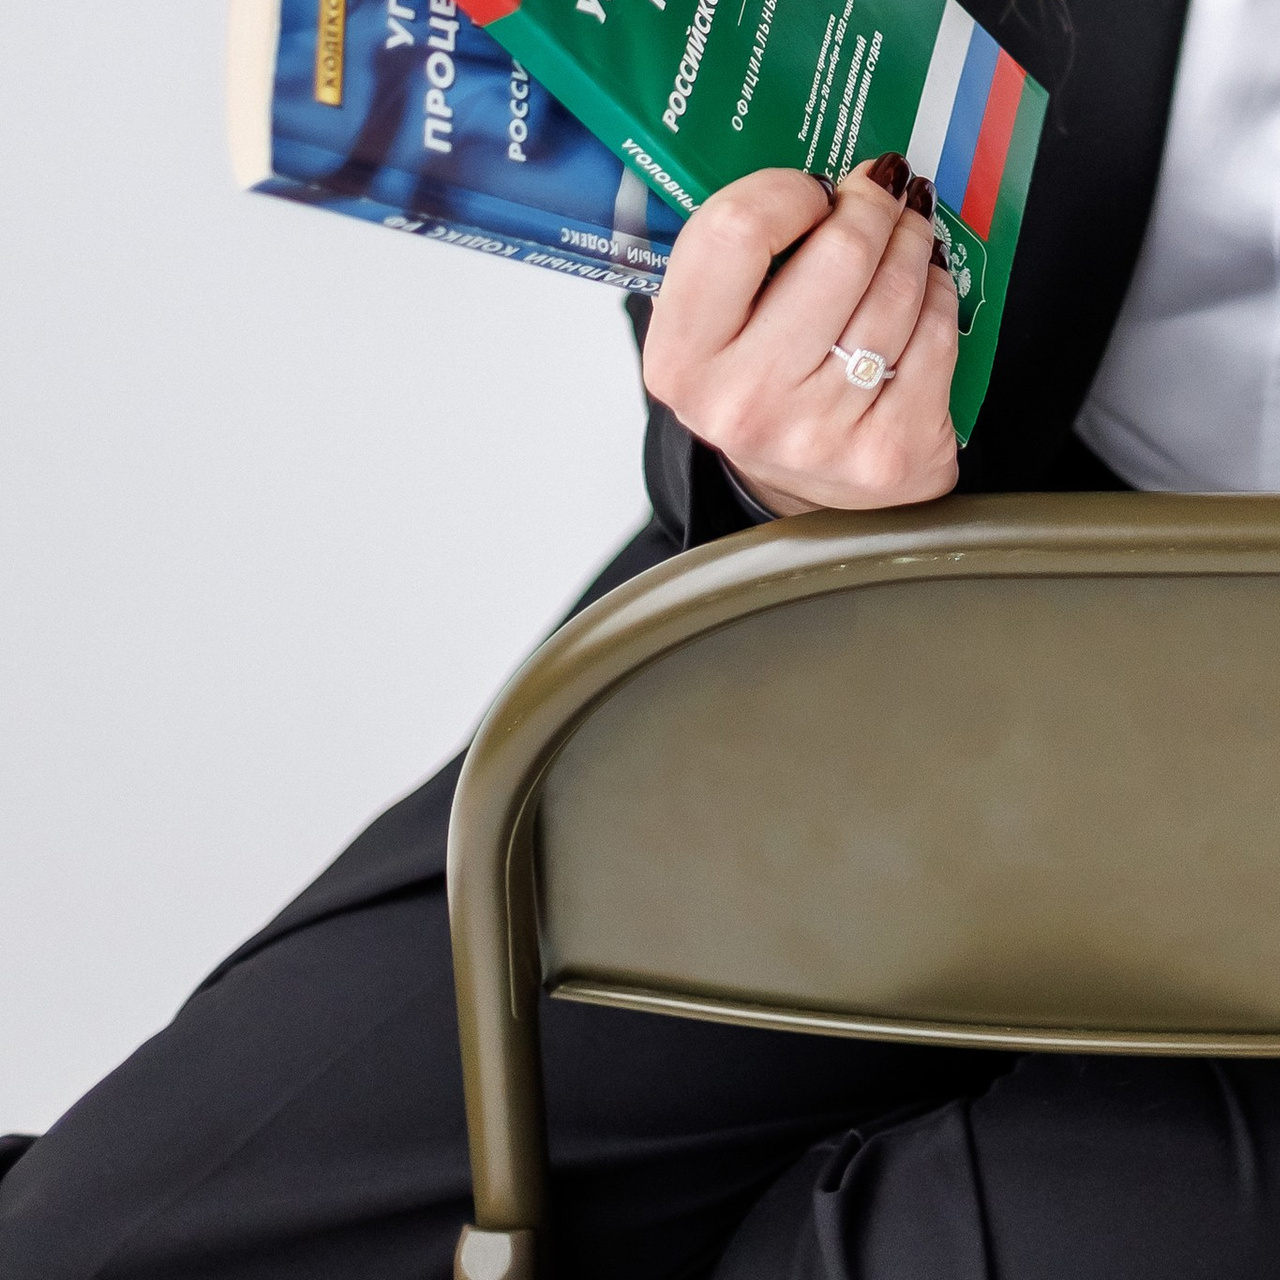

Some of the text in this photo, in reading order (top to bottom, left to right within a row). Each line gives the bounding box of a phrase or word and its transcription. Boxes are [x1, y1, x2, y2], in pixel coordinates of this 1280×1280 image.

[834, 18, 847, 45] 2022
[866, 30, 884, 72] СУДОВ
[798, 13, 837, 142] Текст Кодекса приводится
[826, 46, 841, 86] октября
[508, 58, 528, 161] РОССИ
[819, 101, 828, 115] на
[821, 83, 831, 101] 20
[824, 34, 868, 179] С ТАБЛИЦЕЙ ИЗМЕНЕНИЙ
[805, 113, 824, 168] состоянию
[621, 138, 700, 212] УГОЛОВНЫ
[424, 220, 520, 257] КОДЕКС
[560, 227, 620, 256] КОДЕКС
[523, 251, 660, 292] ССУАЛЬНЫЙ
